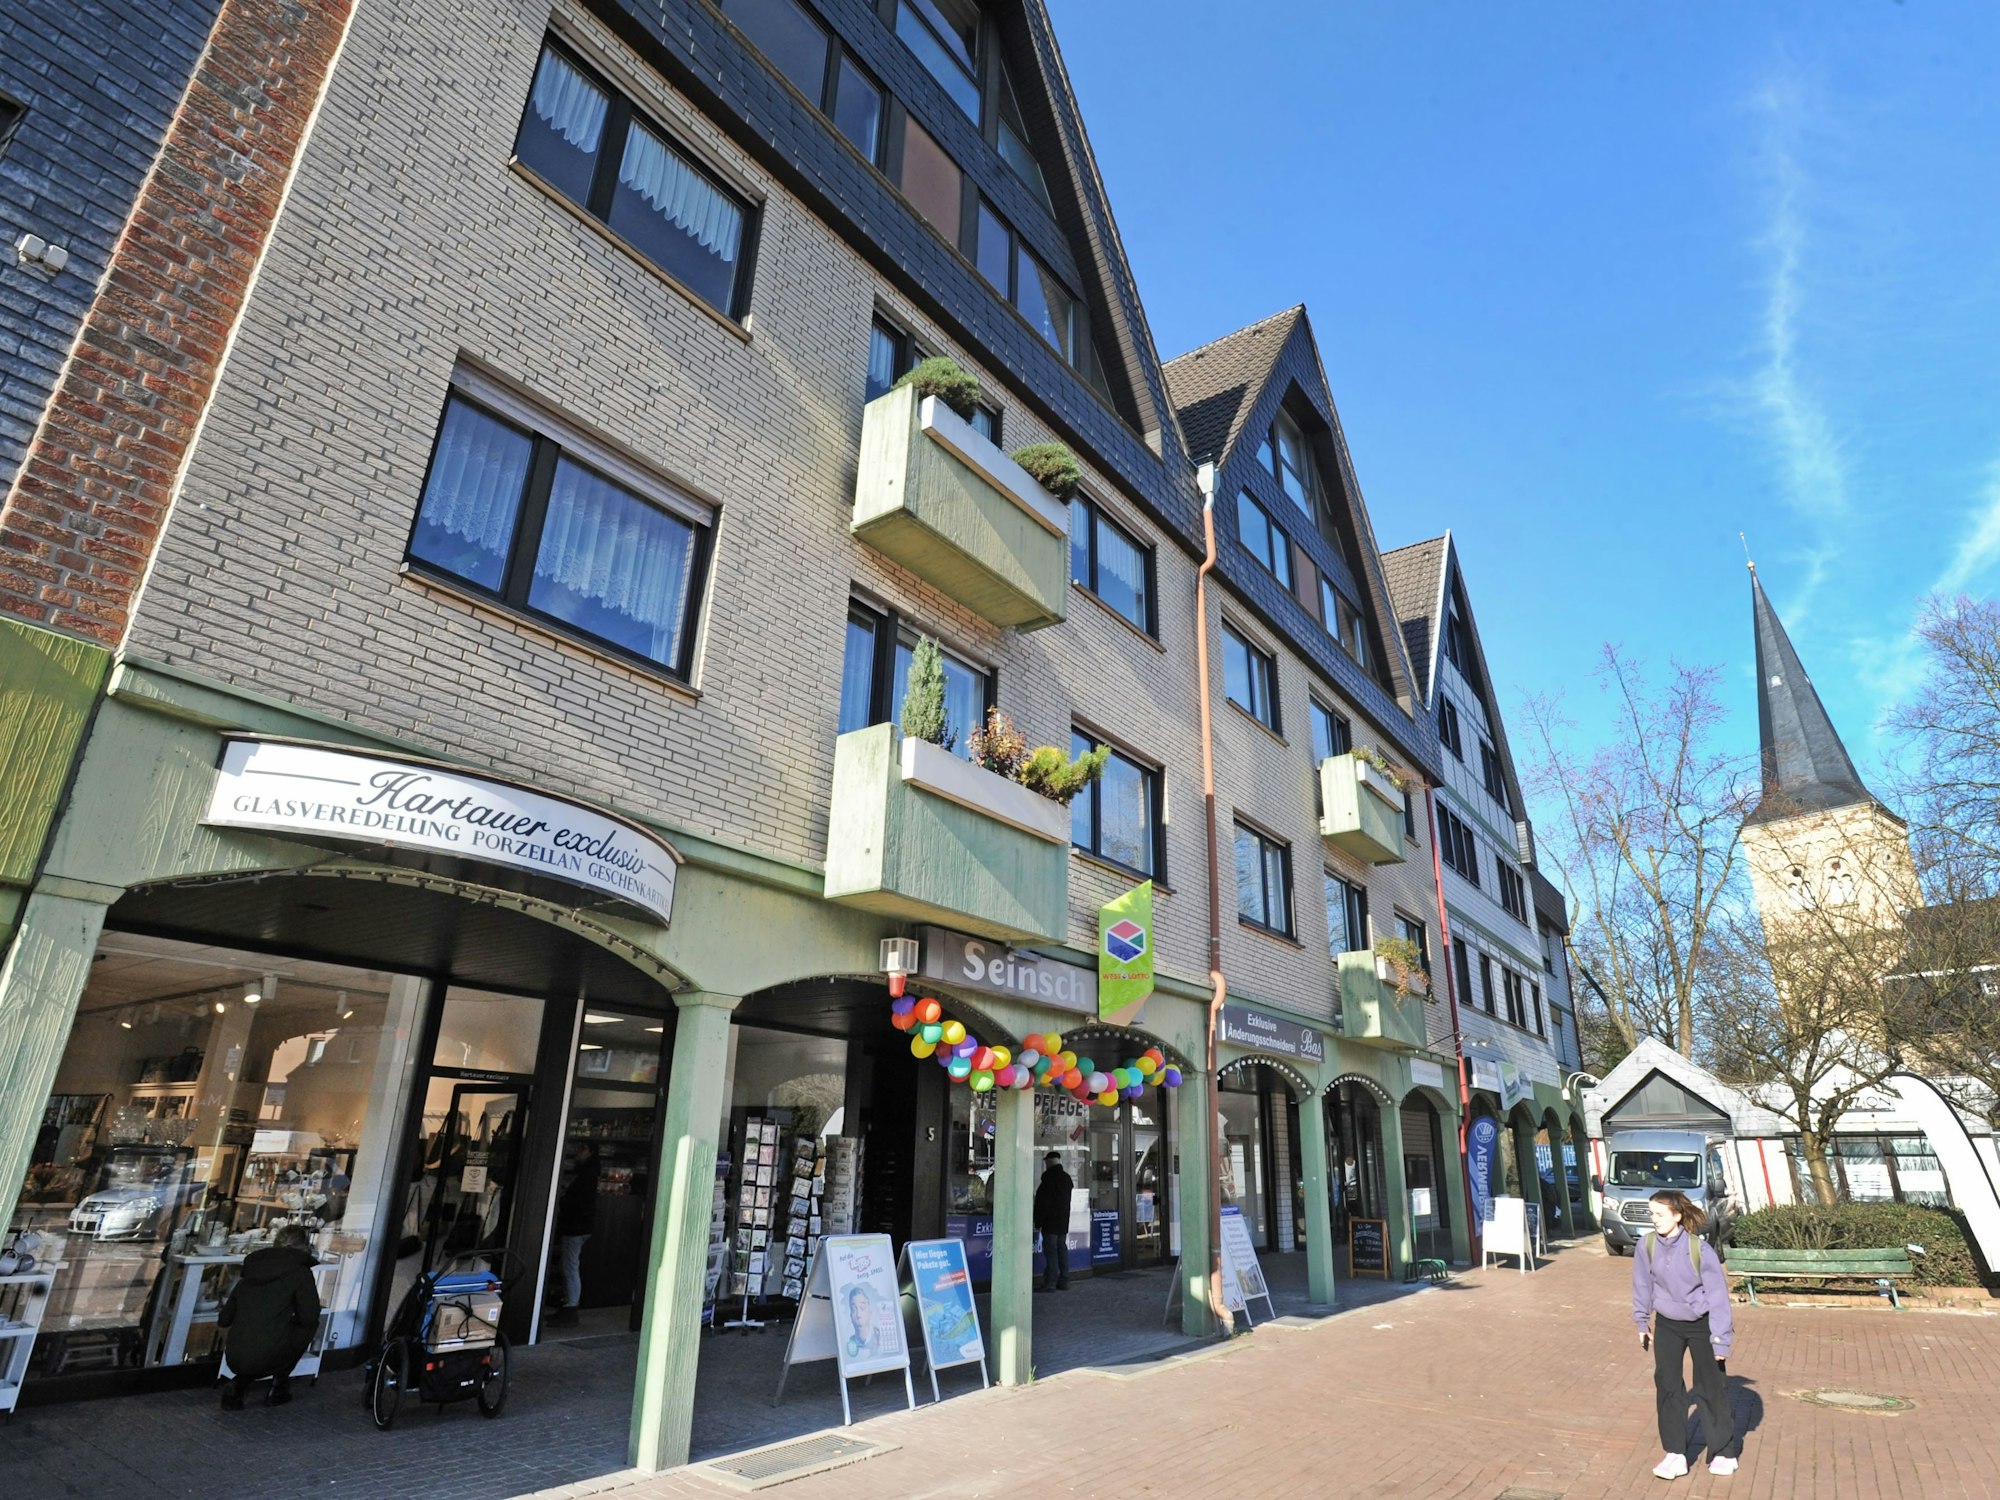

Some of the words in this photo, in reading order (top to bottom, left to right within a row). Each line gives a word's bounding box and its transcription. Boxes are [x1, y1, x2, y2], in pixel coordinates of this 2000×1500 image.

[356, 771, 550, 836] Hartauer
[553, 829, 647, 875] exclusiv
[233, 795, 461, 842] GLASVEREDELUNG
[472, 830, 582, 872] PORZELLAN
[588, 862, 670, 916] GESCHENKARTIKEL
[963, 941, 1087, 1004] Seinsch
[1227, 1022, 1296, 1053] Änderungsschneiderei
[1247, 1013, 1278, 1032] Exklusive
[928, 1127, 935, 1141] 5
